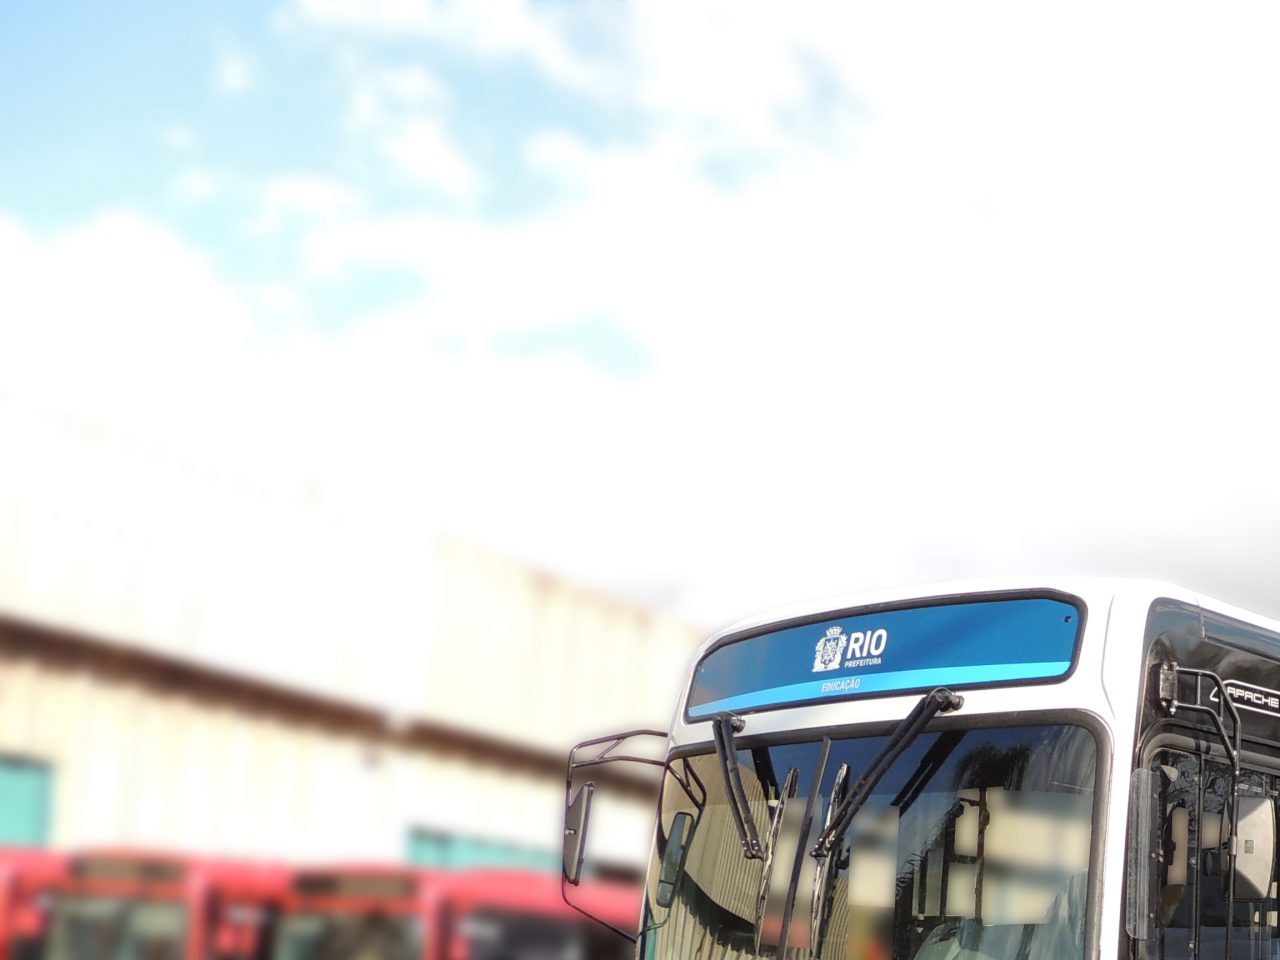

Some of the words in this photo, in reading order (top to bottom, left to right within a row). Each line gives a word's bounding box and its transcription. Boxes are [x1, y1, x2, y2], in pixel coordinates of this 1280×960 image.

[846, 628, 888, 659] RIO
[844, 657, 882, 669] PREFEITURA
[821, 677, 861, 693] EDUCAÇÃO
[1226, 686, 1280, 708] APACHE
